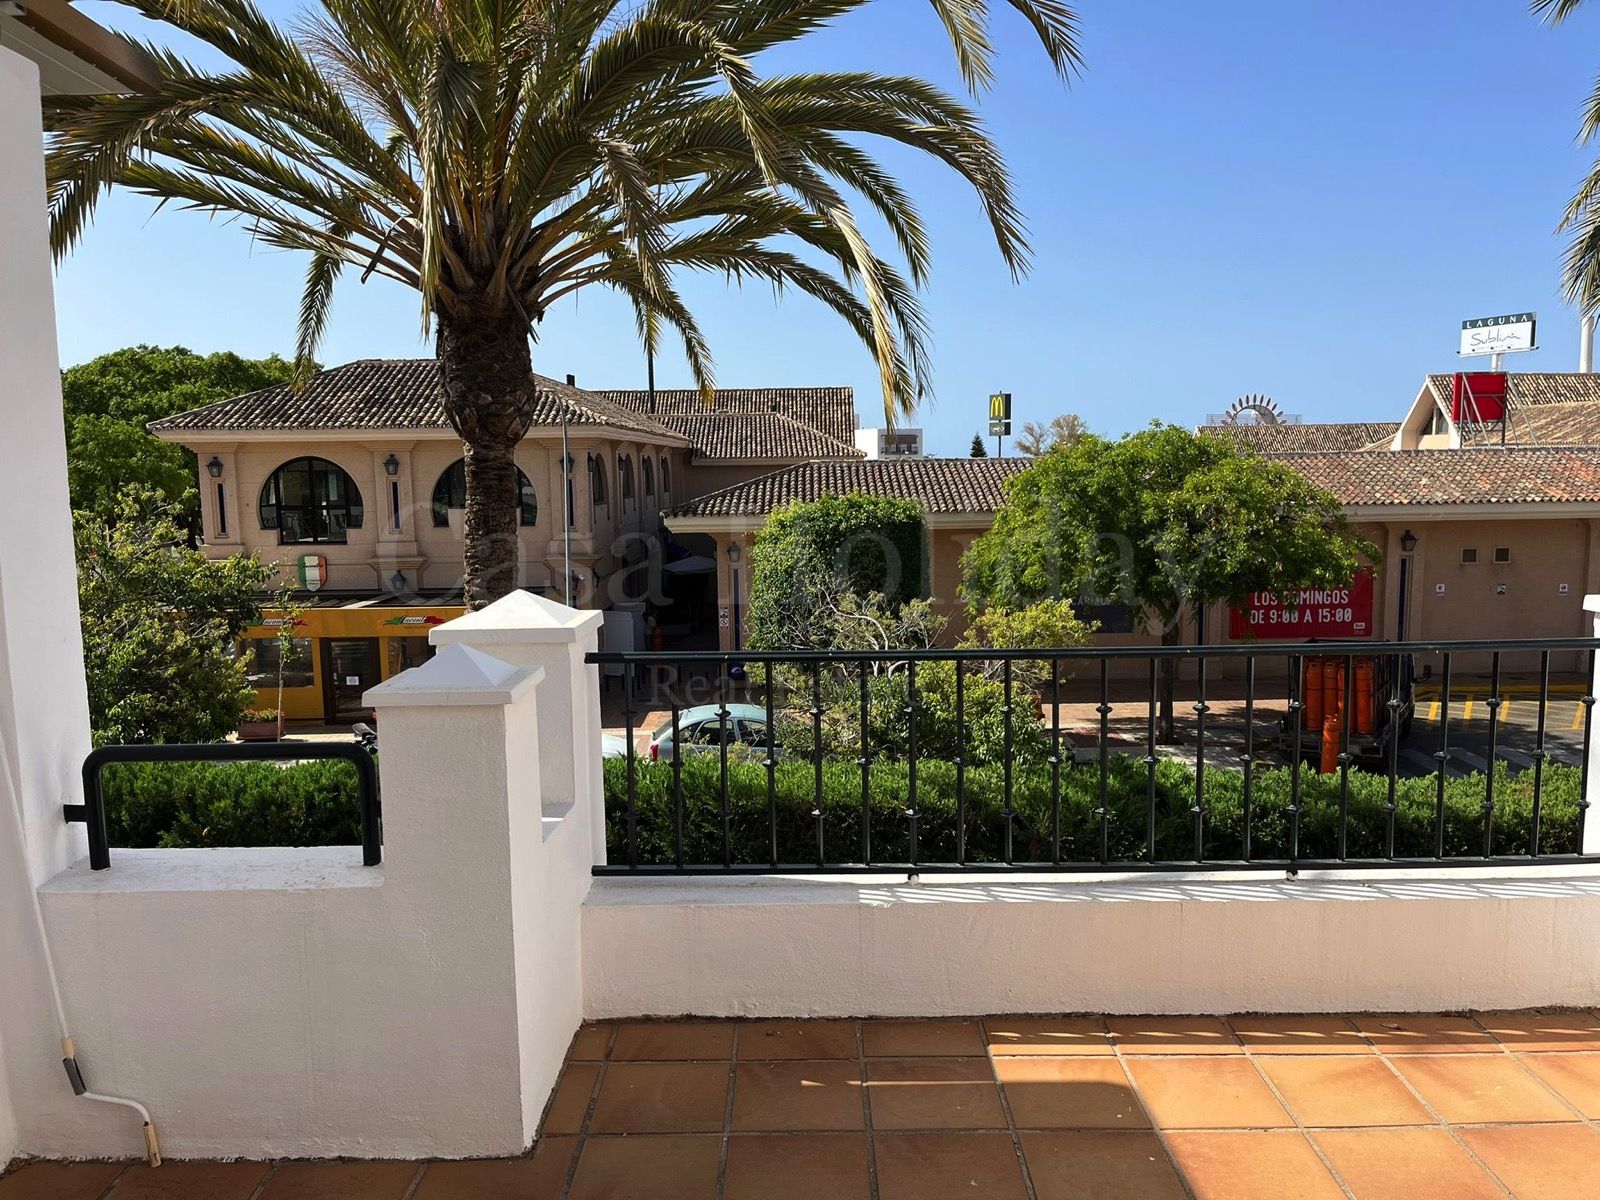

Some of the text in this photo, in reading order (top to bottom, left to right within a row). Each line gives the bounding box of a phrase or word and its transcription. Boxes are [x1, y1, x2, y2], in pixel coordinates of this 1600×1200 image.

[1466, 314, 1528, 329] LAGUNA
[1254, 591, 1278, 606] LOS
[1250, 608, 1353, 624] DE 9:00 A 15:00
